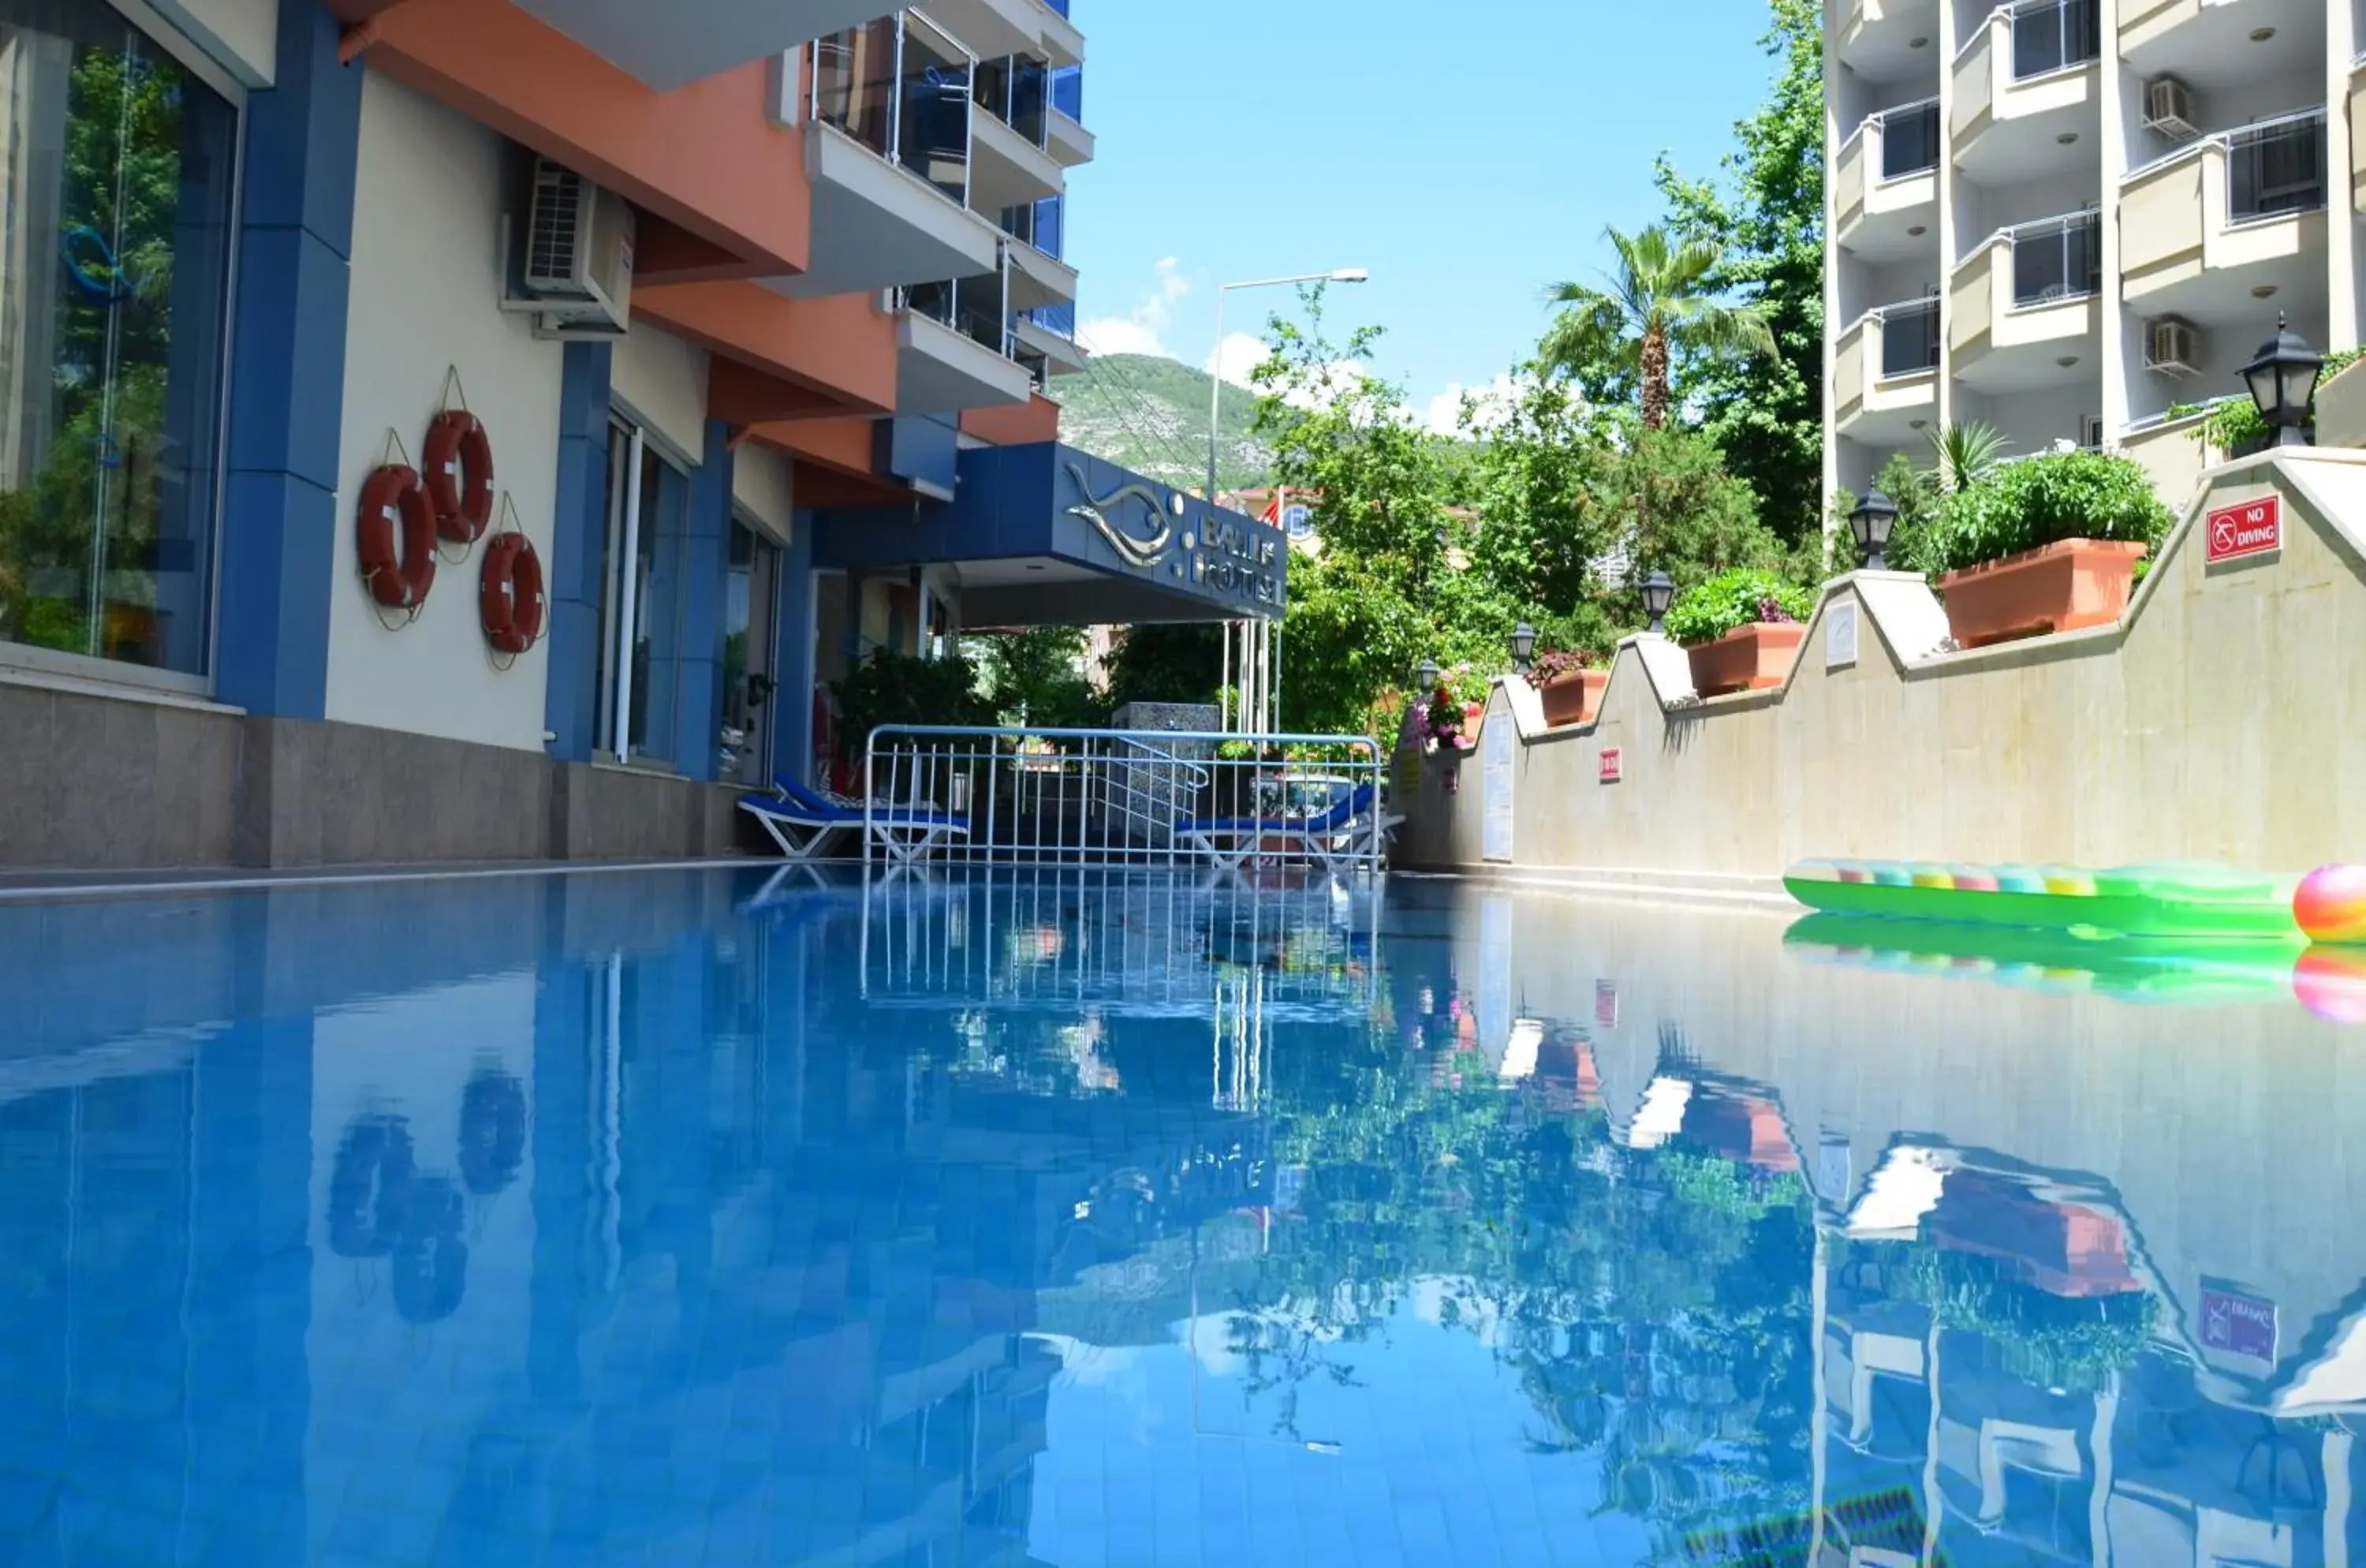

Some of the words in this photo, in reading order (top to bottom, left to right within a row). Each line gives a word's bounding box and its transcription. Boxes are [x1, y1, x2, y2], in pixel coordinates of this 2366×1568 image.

[2247, 507, 2264, 524] NO
[2237, 525, 2274, 546] DIVING
[1192, 552, 1285, 607] HOTEL
